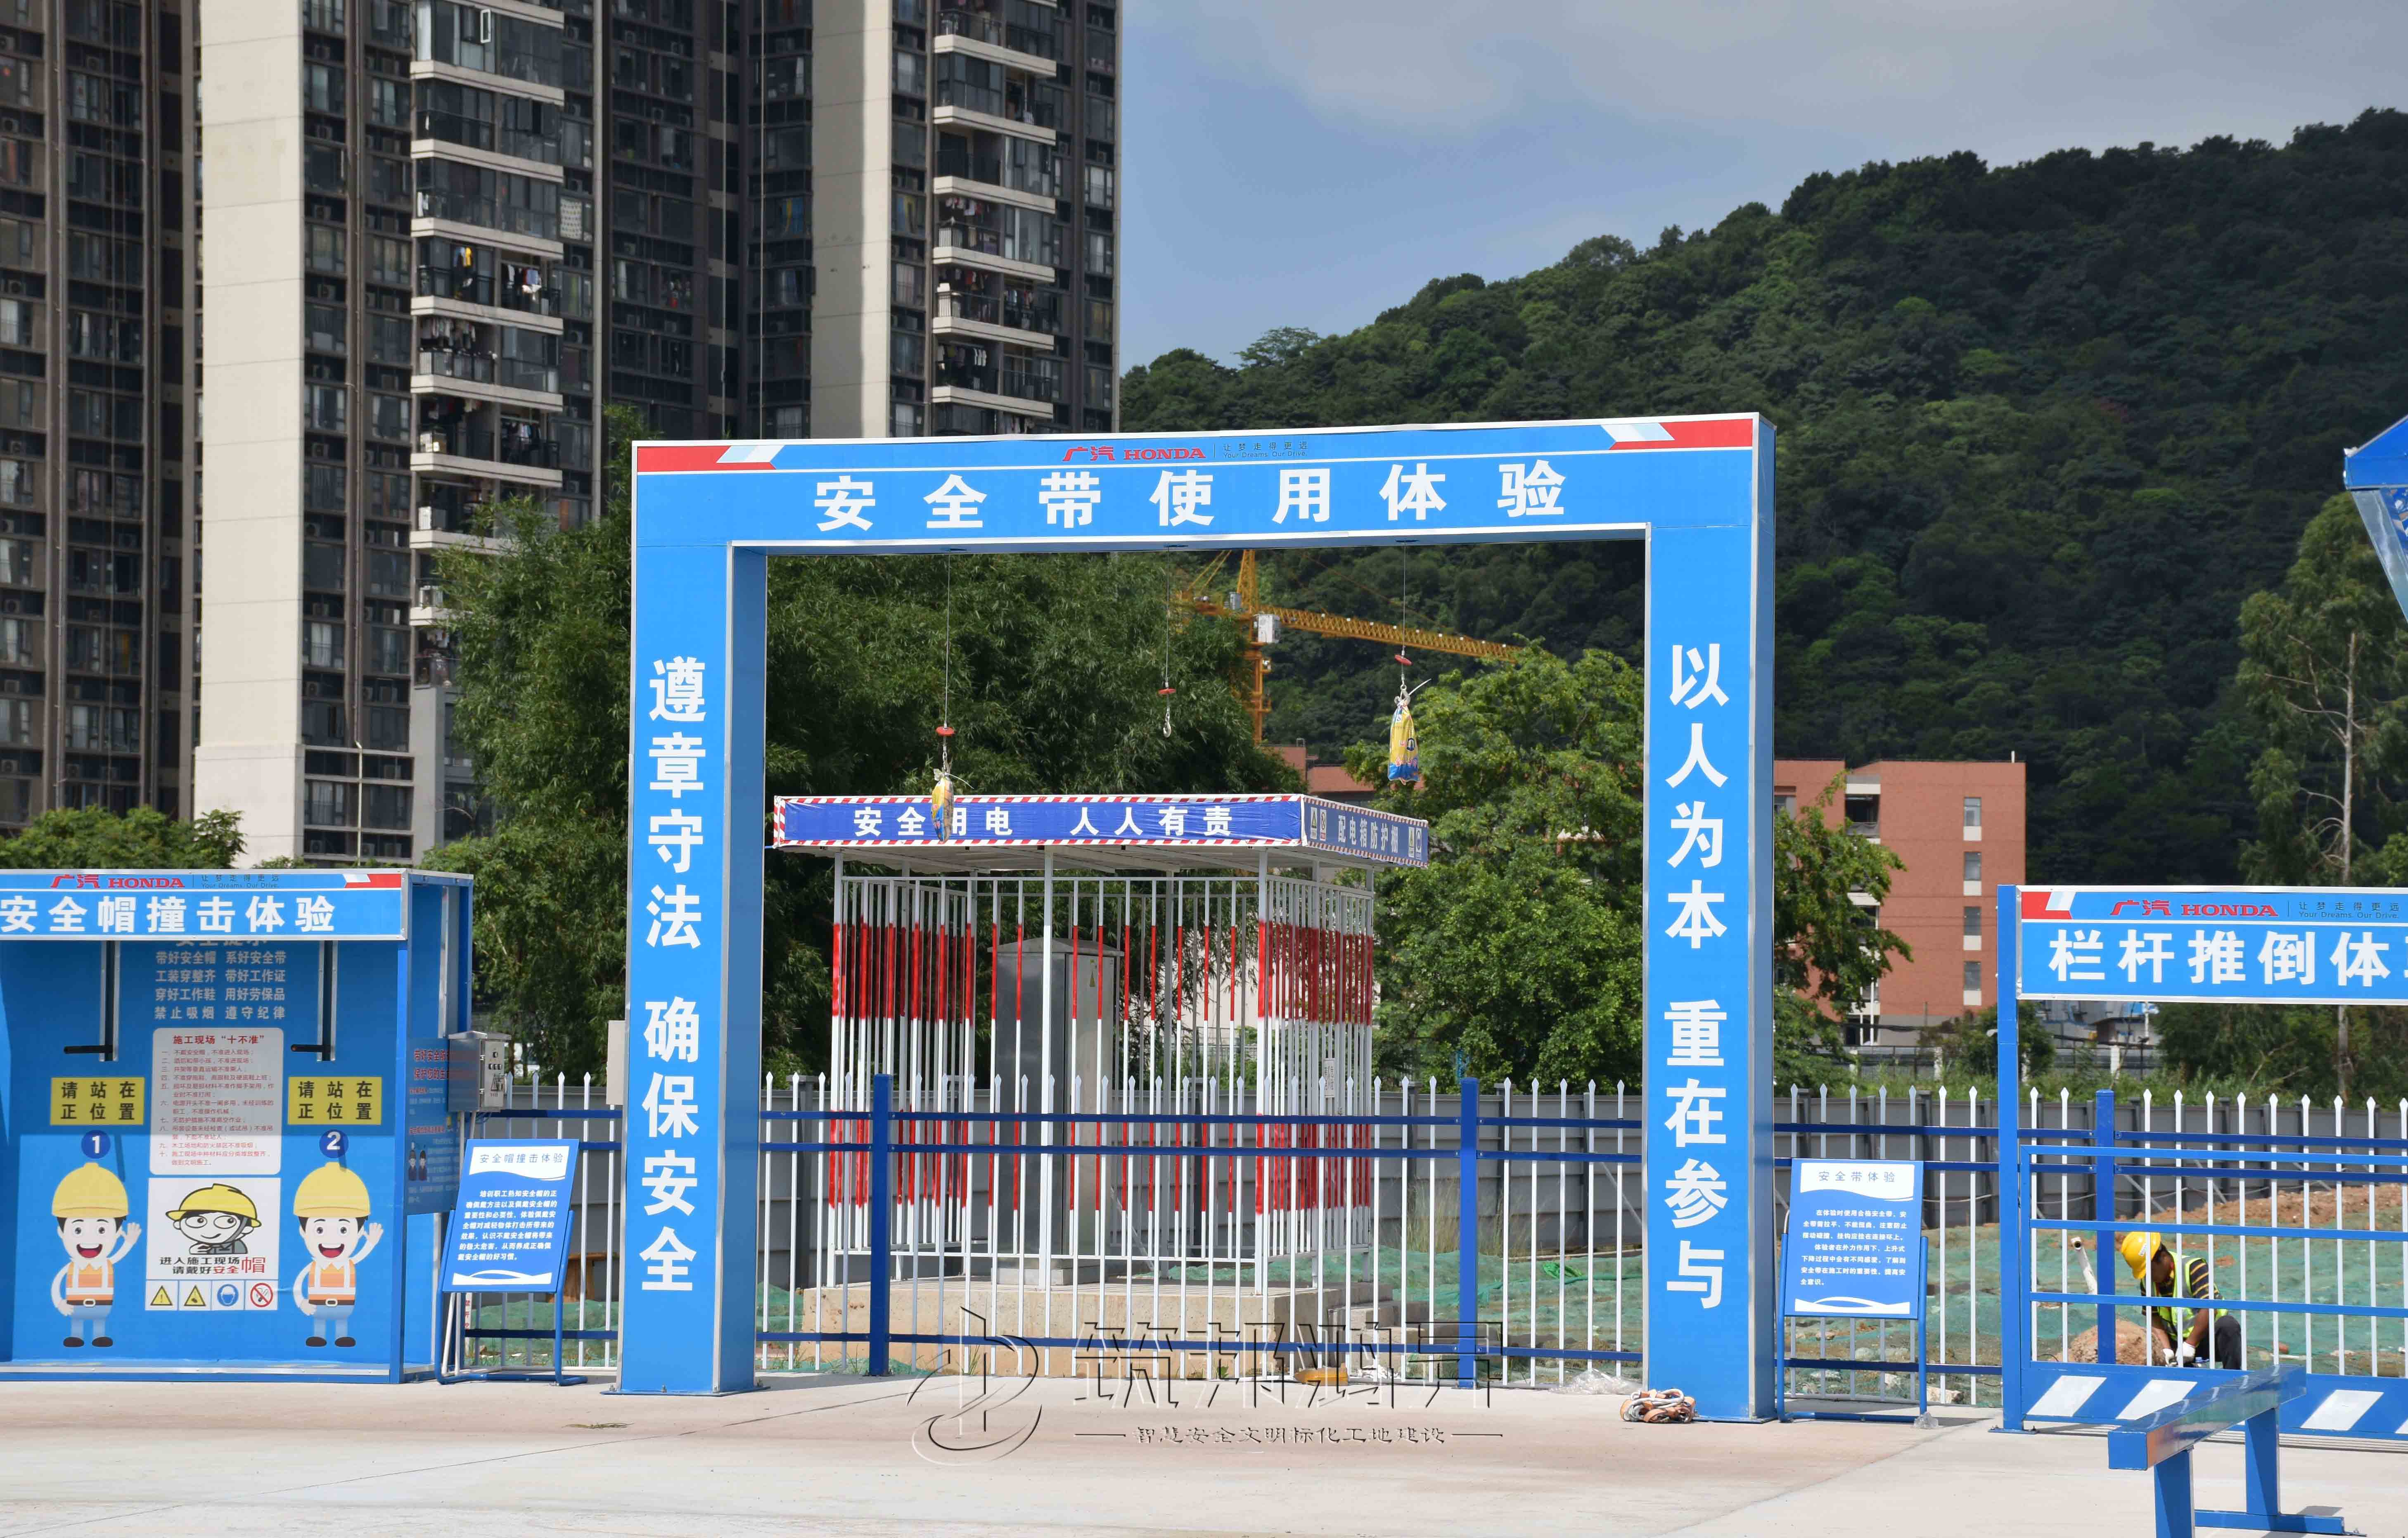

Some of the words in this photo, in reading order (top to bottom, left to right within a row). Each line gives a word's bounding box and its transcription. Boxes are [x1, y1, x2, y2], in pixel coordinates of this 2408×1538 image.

[1063, 446, 1114, 461] 广汽
[1123, 448, 1205, 460] HONDA
[1224, 441, 1308, 451] 让梦走得更远
[814, 460, 1567, 531] 安全带使用体验
[647, 656, 706, 949] 遵章守法
[1666, 643, 1729, 949] 以人为本
[1070, 806, 1232, 837] 人人有责
[50, 874, 100, 888] 广汽
[108, 878, 185, 888] HONDA
[1, 895, 335, 933] 安全帽撞击体验
[2110, 900, 2171, 916] 广汽
[2181, 904, 2278, 917] HONDA
[2299, 902, 2399, 911] 让梦走得更远
[156, 951, 216, 964] 带好安全帽
[226, 951, 286, 964] 系好安全带
[2049, 929, 2408, 987] 栏杆推倒体
[155, 970, 216, 983] 工装穿整齐
[225, 969, 286, 983] 带好工作证
[155, 988, 216, 1001] 穿好工作鞋
[225, 987, 285, 1001] 用好劳保品
[154, 1006, 214, 1019] 禁止吸烟
[225, 1006, 285, 1019] 遵守纪律
[62, 1081, 135, 1099] 请站在
[298, 1081, 372, 1099] 请站在
[60, 1103, 135, 1120] 正位置
[298, 1102, 372, 1120] 正位置
[92, 1135, 100, 1154] 1
[327, 1131, 341, 1150] 2
[640, 996, 699, 1291] 确保安全
[479, 1153, 563, 1164] 安全帽撞击体验
[1664, 999, 1728, 1309] 重在参与
[1818, 1171, 1895, 1182] 安全带体验
[160, 1257, 240, 1265] 进入施工现场
